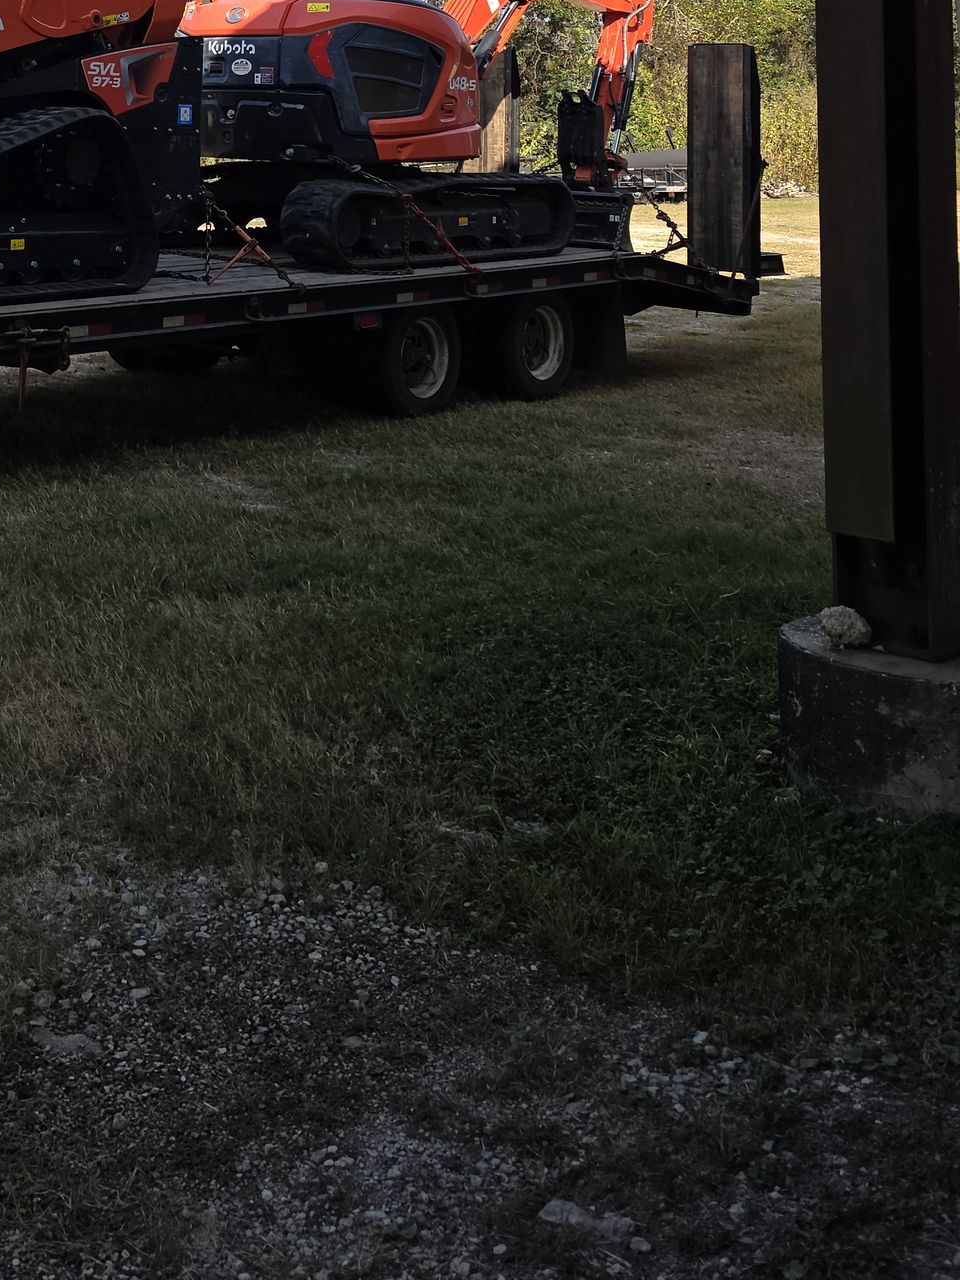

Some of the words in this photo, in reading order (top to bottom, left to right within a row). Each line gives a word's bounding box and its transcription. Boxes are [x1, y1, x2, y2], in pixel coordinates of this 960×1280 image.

[208, 40, 256, 55] Kubota
[88, 61, 121, 77] SVL
[91, 76, 122, 89] 97-3
